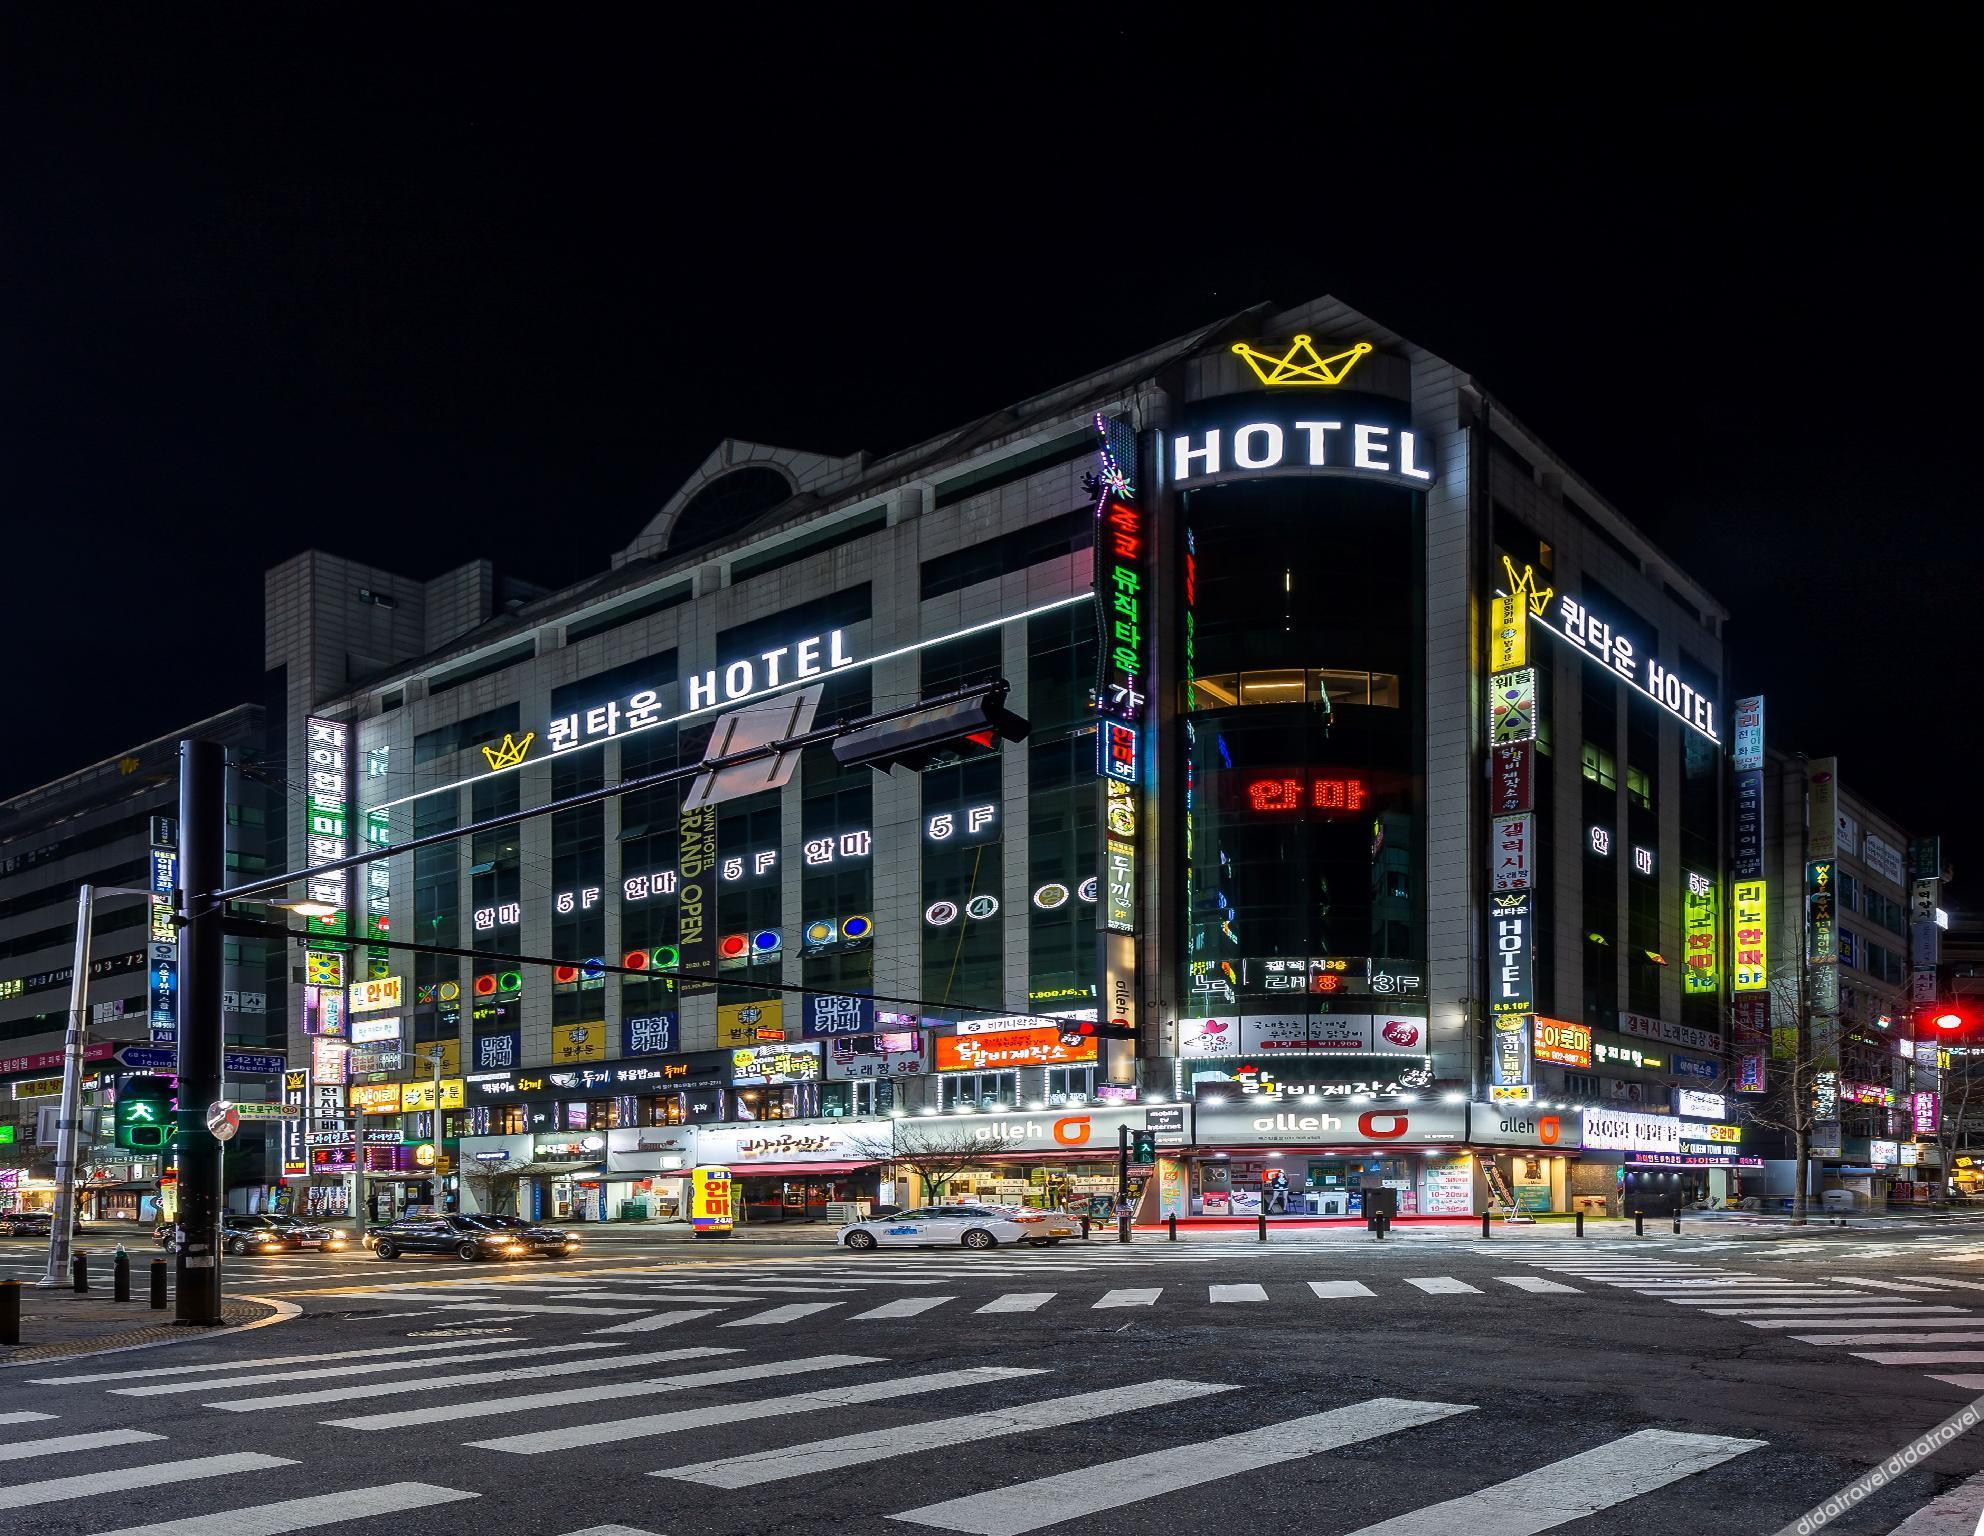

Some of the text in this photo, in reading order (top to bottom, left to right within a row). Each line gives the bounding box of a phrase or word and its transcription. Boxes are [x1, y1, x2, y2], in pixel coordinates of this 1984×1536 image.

[1174, 420, 1431, 481] HOTEL
[1560, 595, 1718, 738] 퀸타운 HOTEL
[547, 629, 853, 752] 퀸타운 HOTEL
[1108, 683, 1145, 708] 7F
[1113, 725, 1134, 765] 안마
[1116, 760, 1135, 775] 5F
[1248, 778, 1366, 811] 안마
[703, 803, 717, 869] OWN HOTEL
[804, 830, 872, 865] 안마
[1501, 822, 1524, 868] 갤럭시
[723, 850, 776, 881] 5F
[1110, 855, 1132, 898] 두끼
[624, 870, 678, 900] 안마
[1689, 872, 1710, 897] 5F
[556, 887, 600, 913] 5F
[1492, 906, 1528, 917] 퀸타운
[1738, 886, 1760, 924] 리노
[474, 902, 520, 930] 안마
[680, 884, 702, 945] OPEN
[1115, 908, 1127, 918] 2F
[1498, 918, 1522, 998] HOTEL
[1737, 928, 1764, 966] 안마
[1373, 974, 1420, 994] 3F
[1738, 971, 1763, 984] 5F
[366, 980, 399, 1003] 안마
[1116, 980, 1130, 1015] olleh
[814, 996, 861, 1015] 만화
[1493, 1002, 1530, 1012] 8.9.10F
[631, 1016, 669, 1034] 만화
[814, 1012, 861, 1034] 카페
[1252, 1020, 1347, 1030] 국내최초 신개념
[1268, 1030, 1363, 1039] 무한리필 닭갈비
[1627, 1015, 1662, 1037] 갤럭시
[1663, 1023, 1708, 1048] 노래연습장
[481, 1036, 512, 1051] 만화
[631, 1031, 669, 1051] 카페
[1543, 1025, 1589, 1052] 아로마
[141, 1059, 178, 1069] Jeong
[481, 1049, 512, 1067] 카페
[844, 1059, 922, 1077] 노래짱 3층
[581, 1069, 609, 1088] 두끼
[664, 1063, 689, 1079] 두끼!
[233, 1104, 281, 1113] 활도로구역
[290, 1091, 302, 1161] HTEL
[975, 1120, 1043, 1141] olleh
[1253, 1113, 1342, 1132] olleh
[1499, 1116, 1535, 1134] olleh
[704, 1180, 730, 1216] 안마
